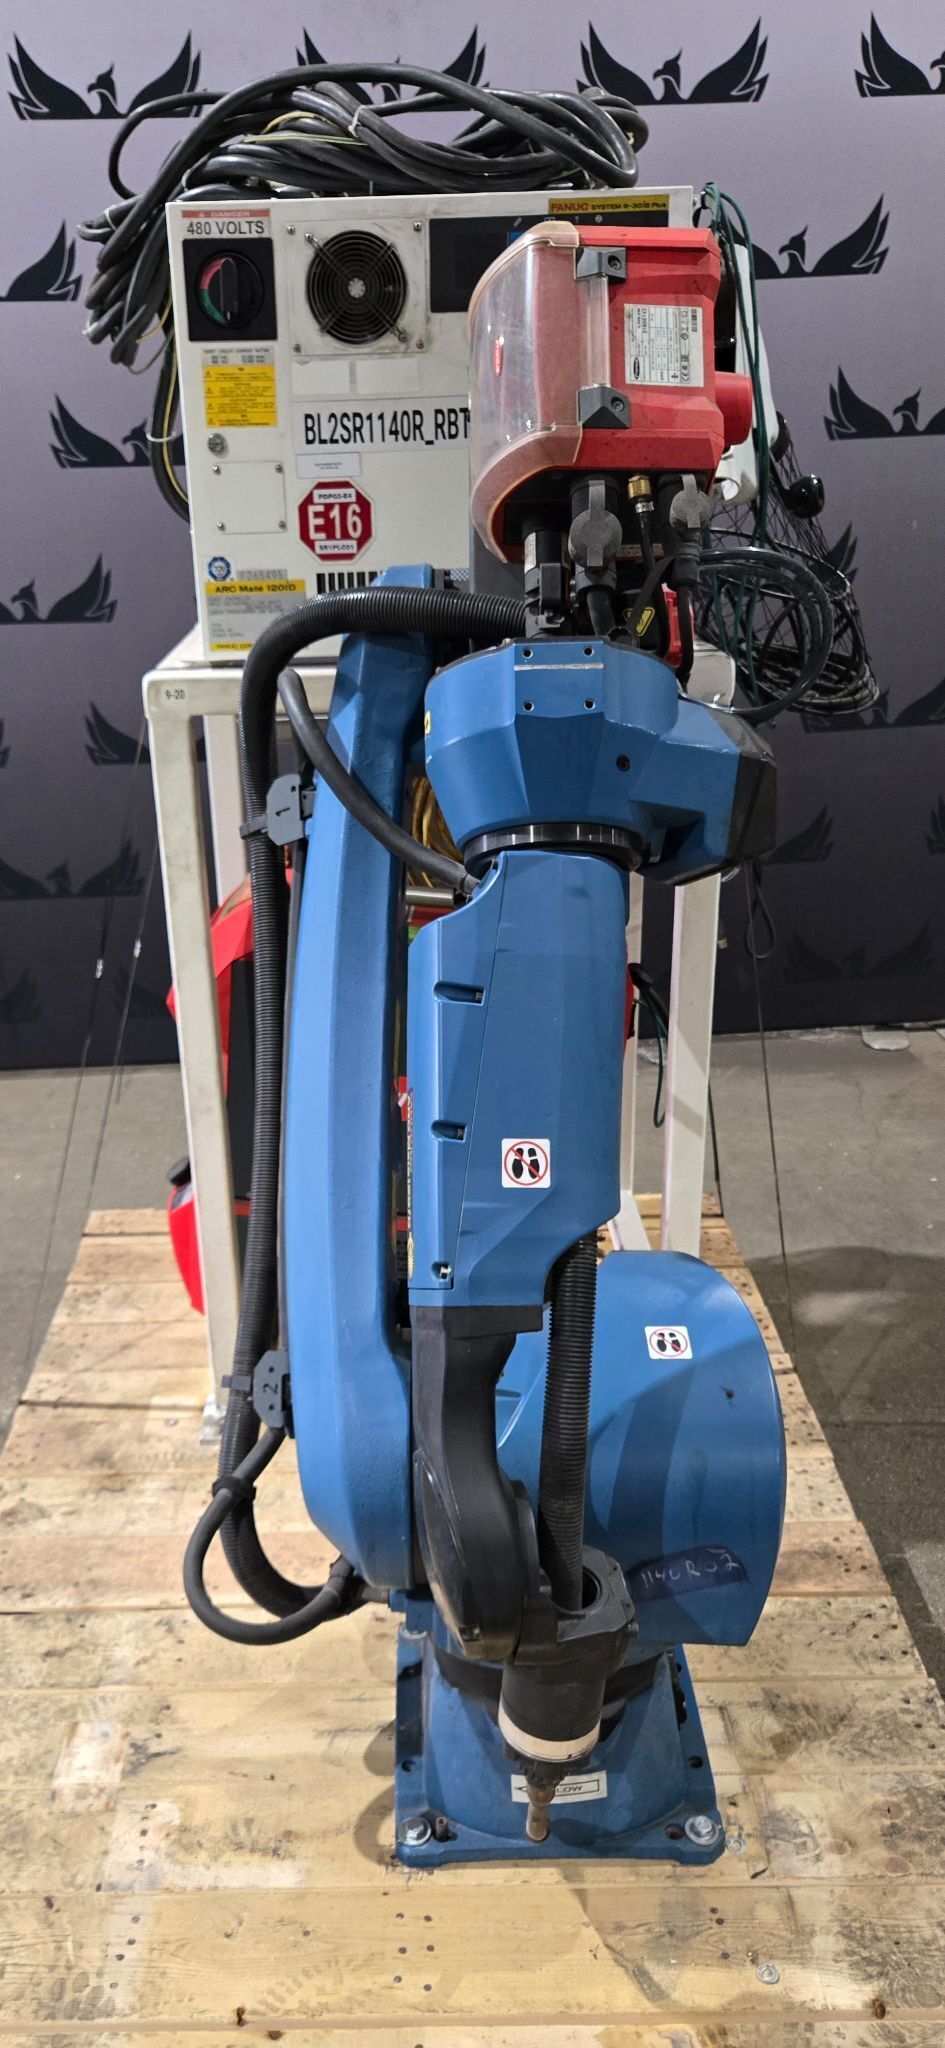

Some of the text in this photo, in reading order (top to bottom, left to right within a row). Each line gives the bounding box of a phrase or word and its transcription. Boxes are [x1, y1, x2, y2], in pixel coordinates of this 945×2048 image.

[550, 203, 589, 212] FANUC
[591, 203, 621, 211] SYSTEM
[187, 220, 265, 235] 480 VOLTS
[307, 503, 362, 540] E16
[165, 689, 186, 700] 9-20
[263, 1383, 278, 1394] 2
